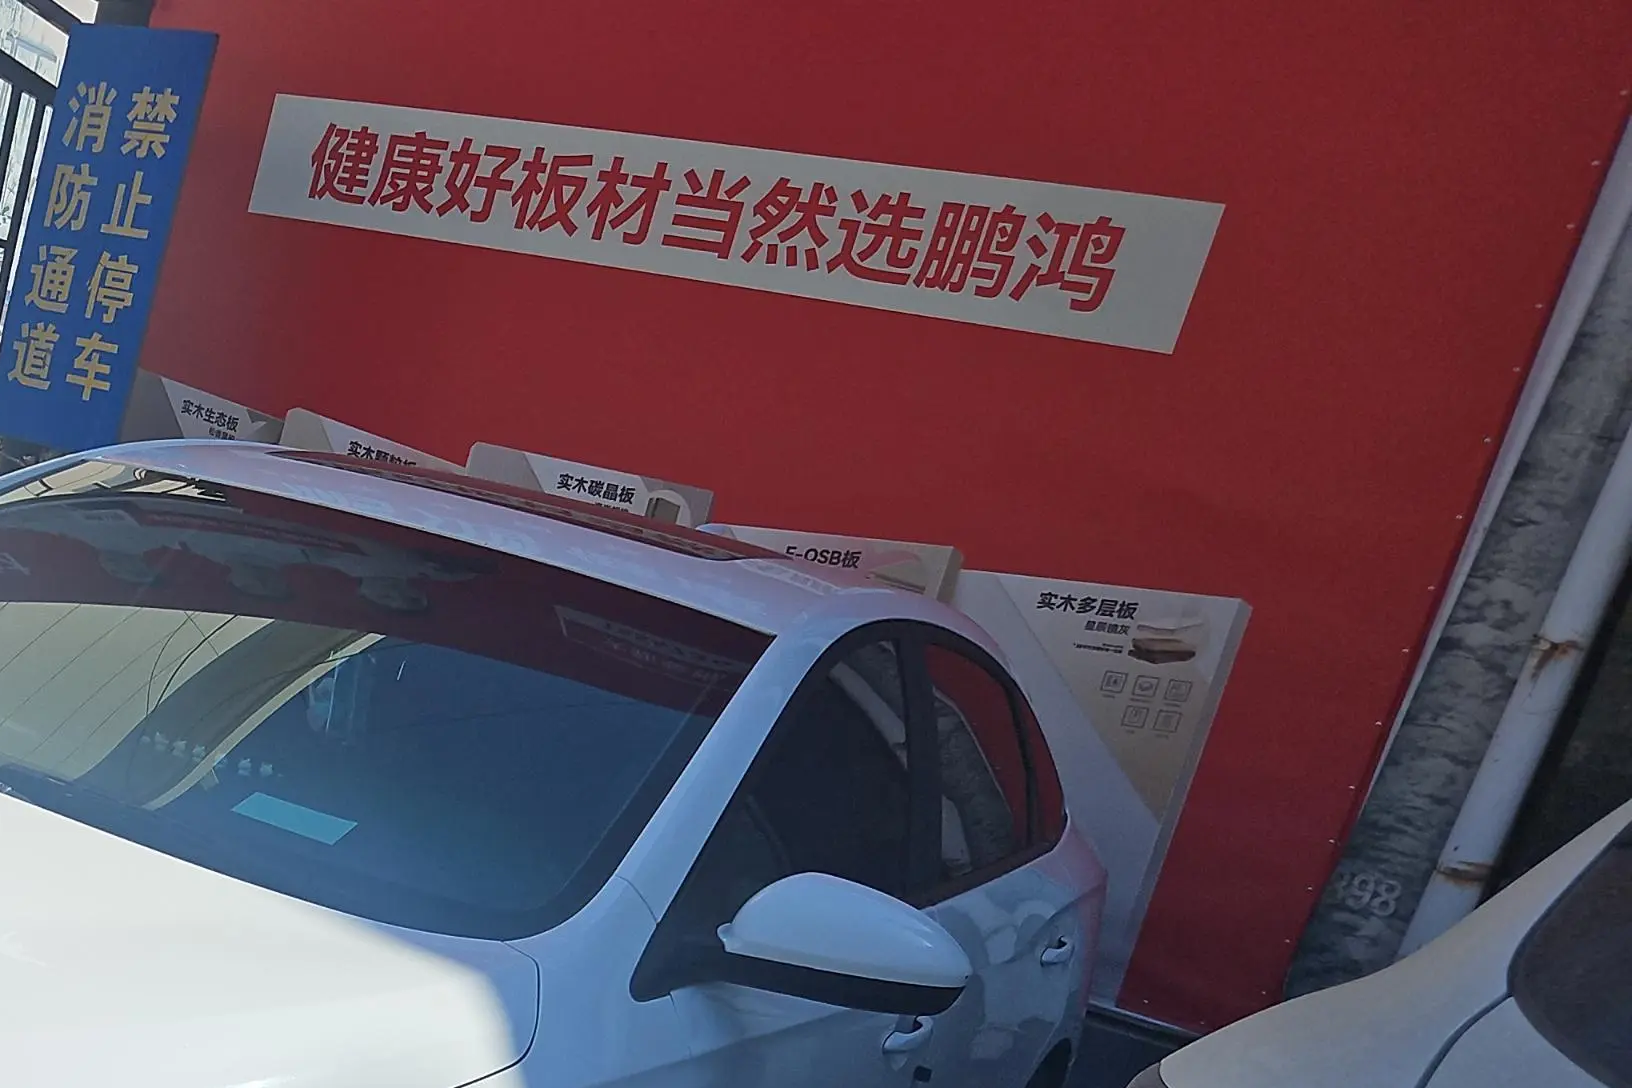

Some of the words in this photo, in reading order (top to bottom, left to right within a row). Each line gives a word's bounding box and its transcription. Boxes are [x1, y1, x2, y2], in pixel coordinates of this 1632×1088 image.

[7, 81, 117, 391] 消防通道
[65, 86, 180, 402] 禁止停车
[309, 121, 1127, 313] 健康好板材当然选鹏鸿
[180, 399, 240, 433] 实木生态板
[556, 472, 636, 505] 实木碳晶板
[1036, 591, 1139, 620] 实木多层板
